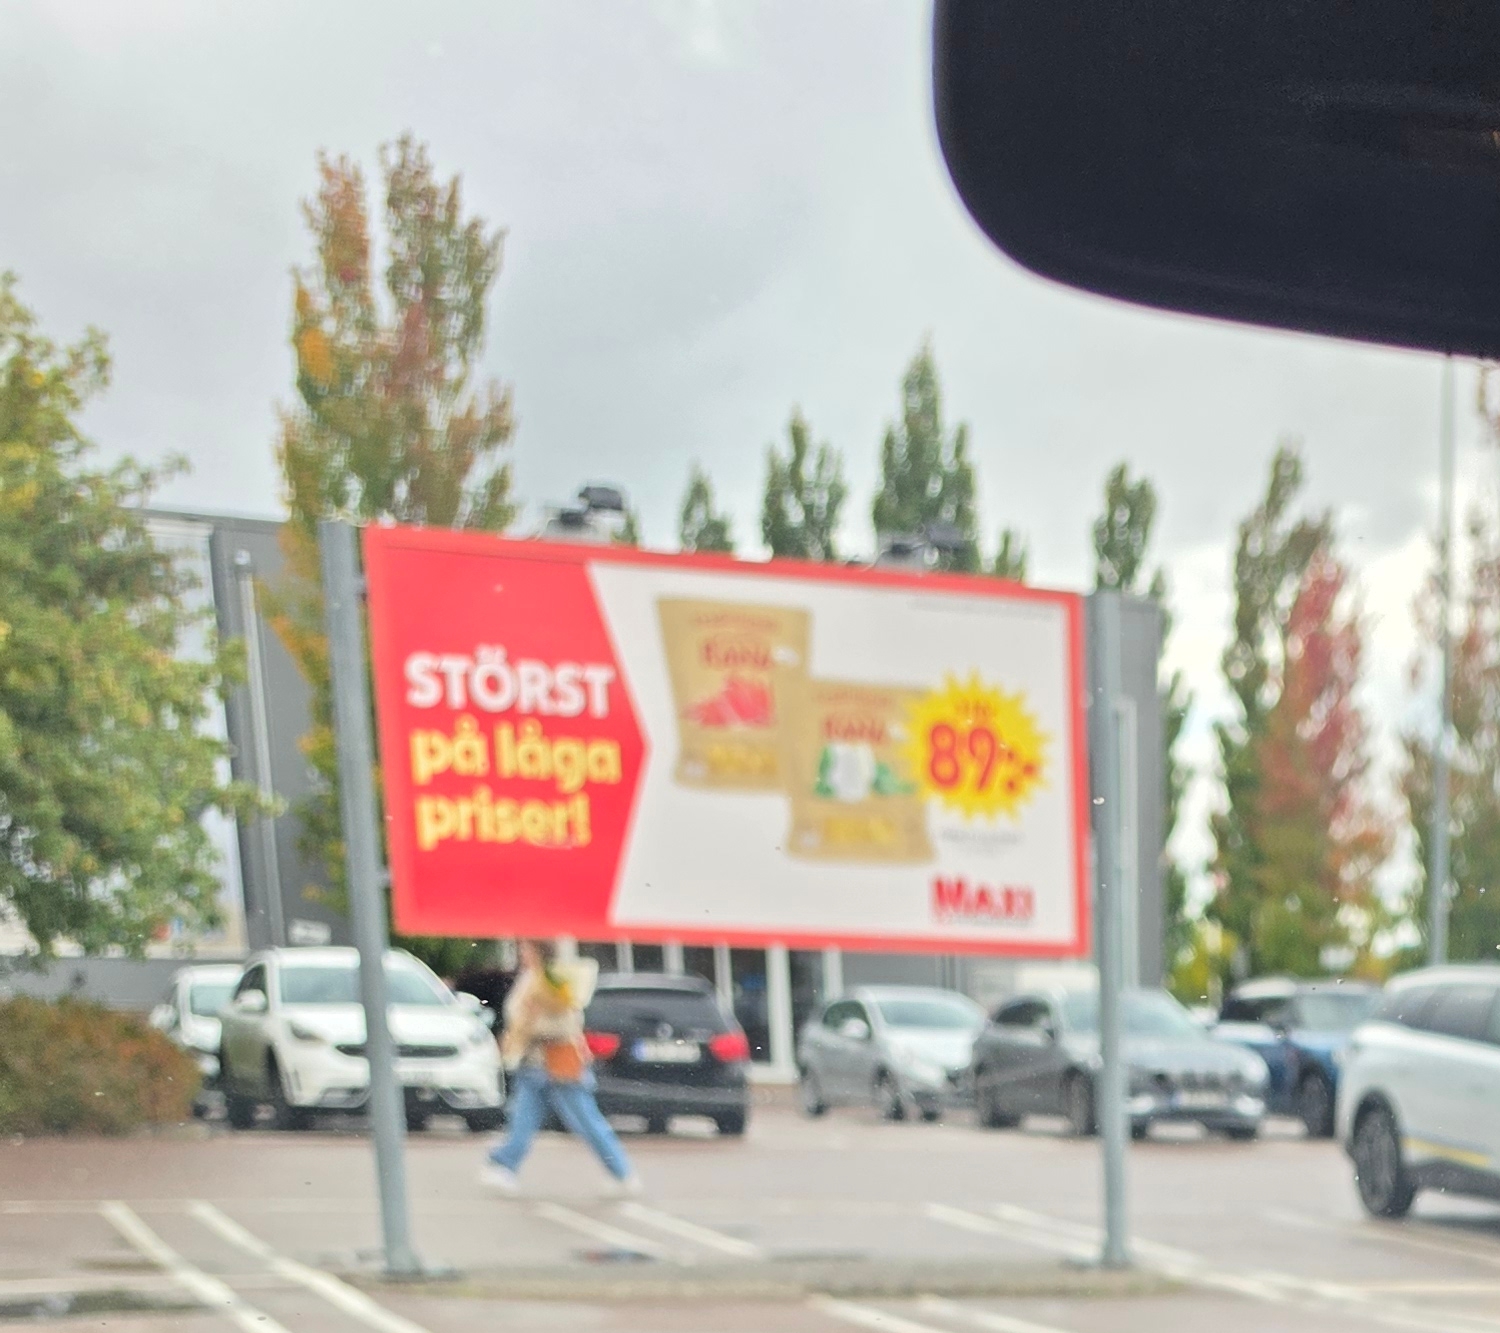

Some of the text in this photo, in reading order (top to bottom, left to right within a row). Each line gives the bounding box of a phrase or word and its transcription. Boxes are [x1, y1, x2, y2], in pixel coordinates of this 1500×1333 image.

[404, 643, 615, 719] STÖRST
[409, 712, 622, 793] på låga
[415, 785, 592, 851] priser!
